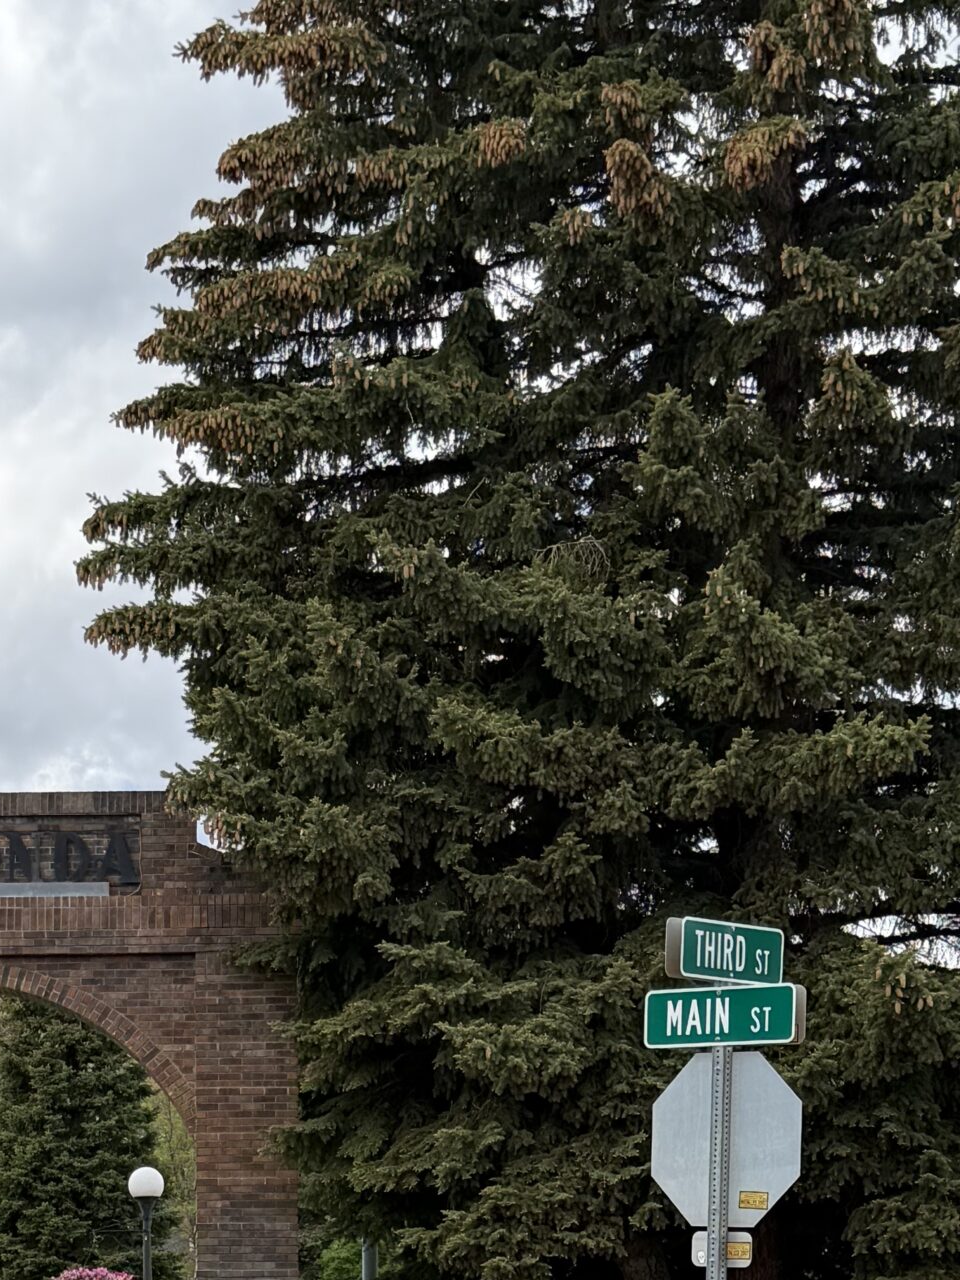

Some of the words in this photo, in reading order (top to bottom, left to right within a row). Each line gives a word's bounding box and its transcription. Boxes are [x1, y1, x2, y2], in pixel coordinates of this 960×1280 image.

[695, 929, 746, 972] THIRD
[754, 949, 770, 975] ST
[666, 997, 730, 1036] MAIN
[750, 1006, 772, 1033] ST
